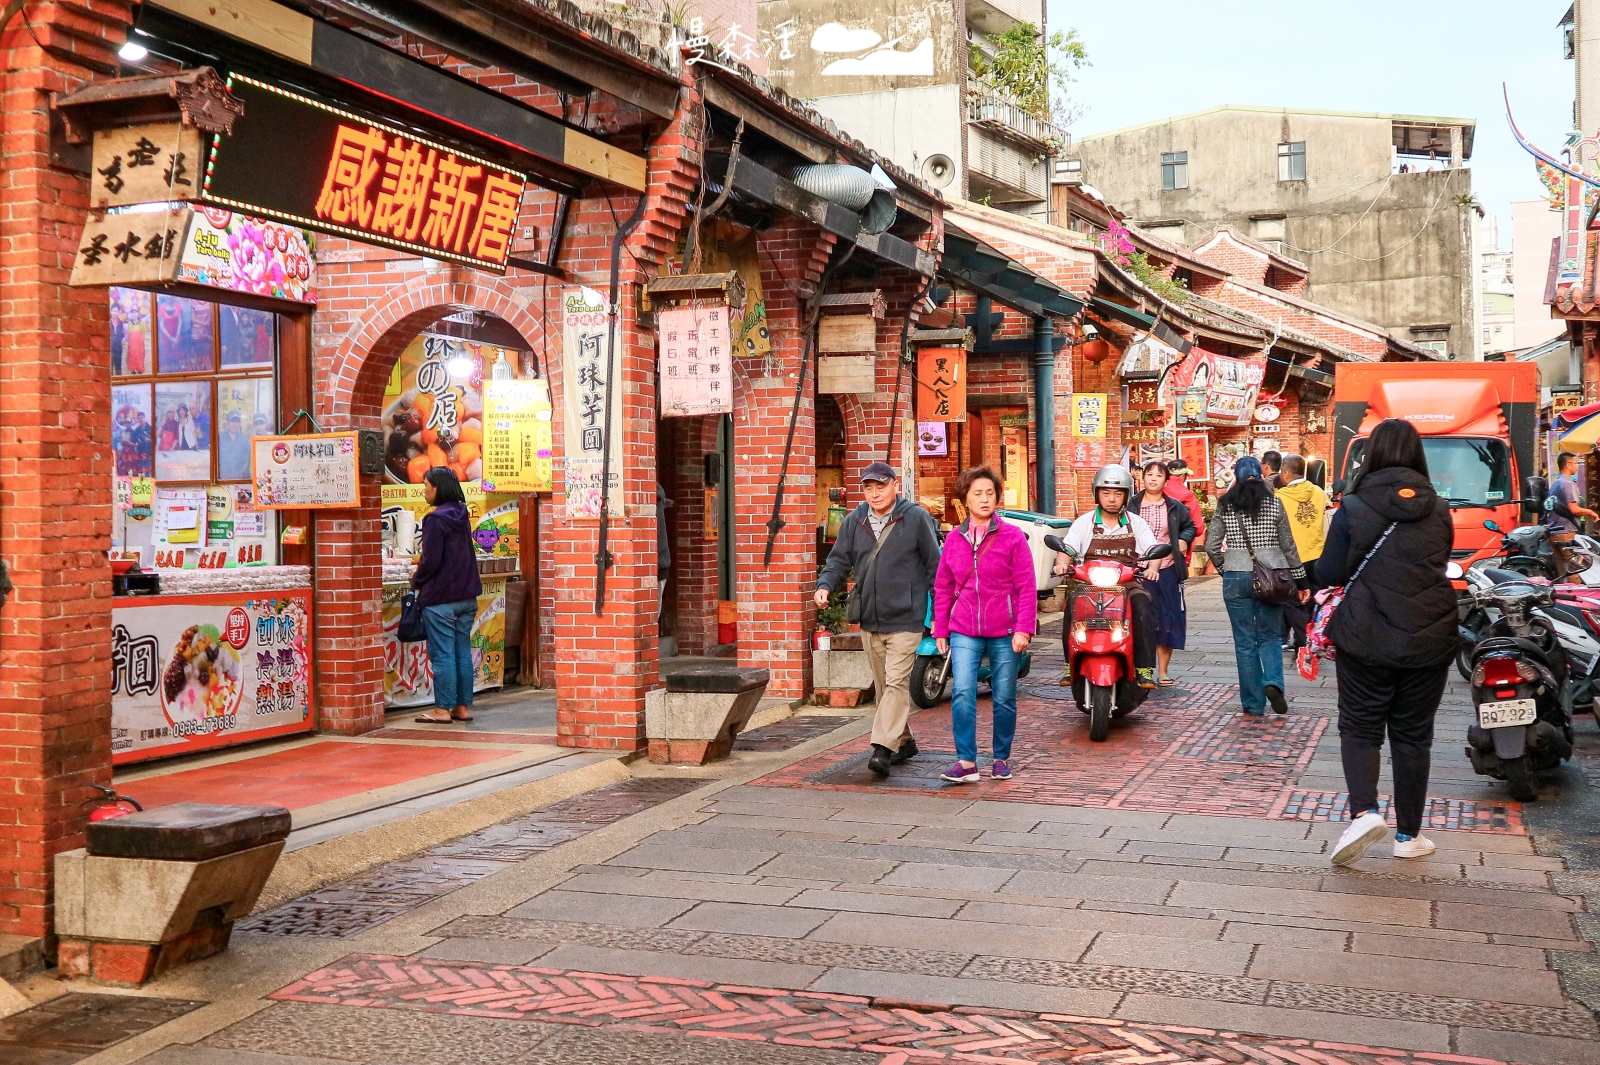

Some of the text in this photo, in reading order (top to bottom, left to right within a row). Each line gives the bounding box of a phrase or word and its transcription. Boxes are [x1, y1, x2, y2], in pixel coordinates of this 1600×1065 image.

[316, 125, 523, 262] 感謝新唐
[195, 228, 219, 247] A-ju
[264, 227, 287, 251] 懷舊
[196, 244, 231, 260] Taro balls
[286, 258, 309, 278] 創新
[577, 332, 606, 453] 阿珠芋圓
[293, 442, 334, 458] 阿珠芋圓
[229, 614, 245, 628] 堅持
[256, 615, 295, 647] 刨冰
[229, 628, 245, 641] 手工
[256, 649, 295, 680] 冷湯
[256, 682, 295, 715] 熱湯
